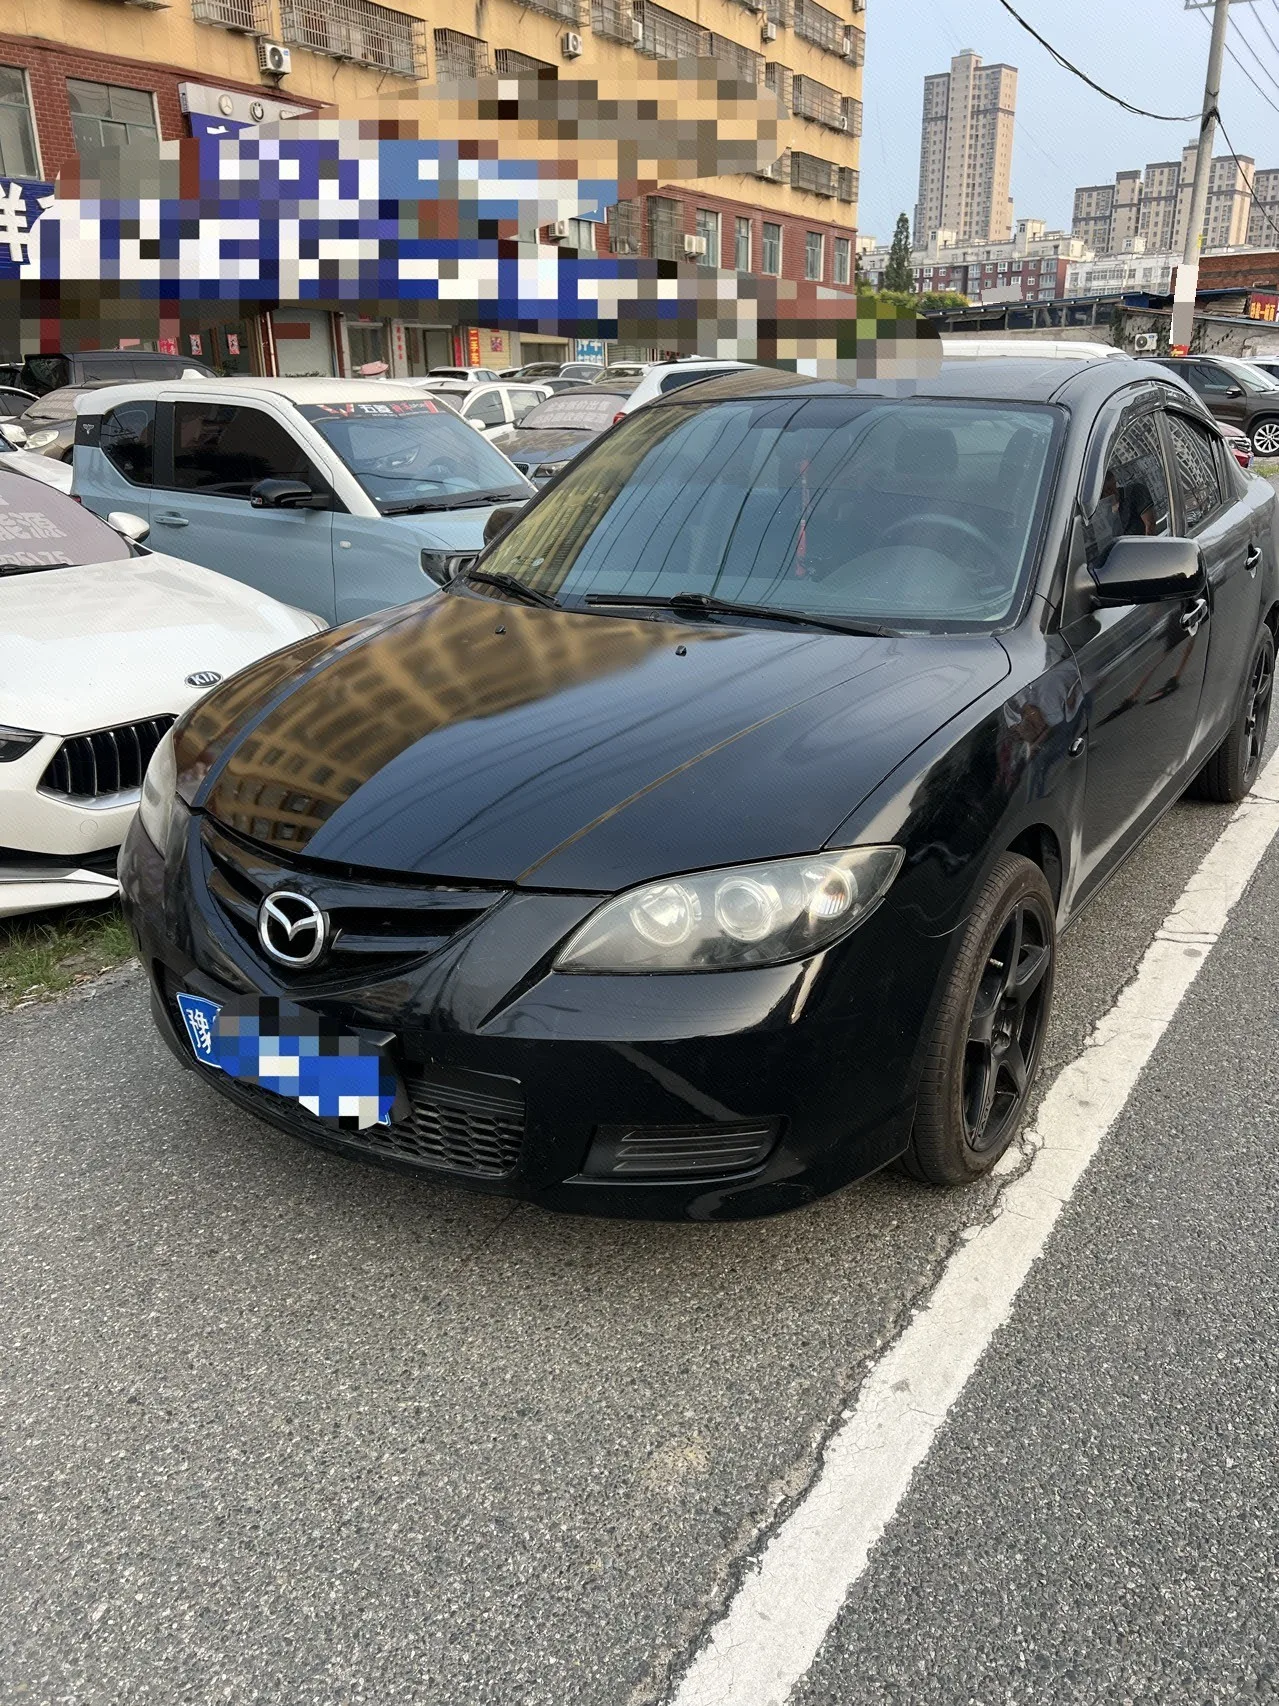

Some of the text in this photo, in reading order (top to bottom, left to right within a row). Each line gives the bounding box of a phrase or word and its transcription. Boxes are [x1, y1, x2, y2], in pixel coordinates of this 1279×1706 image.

[468, 329, 480, 368] 二手车
[190, 672, 220, 685] KIA
